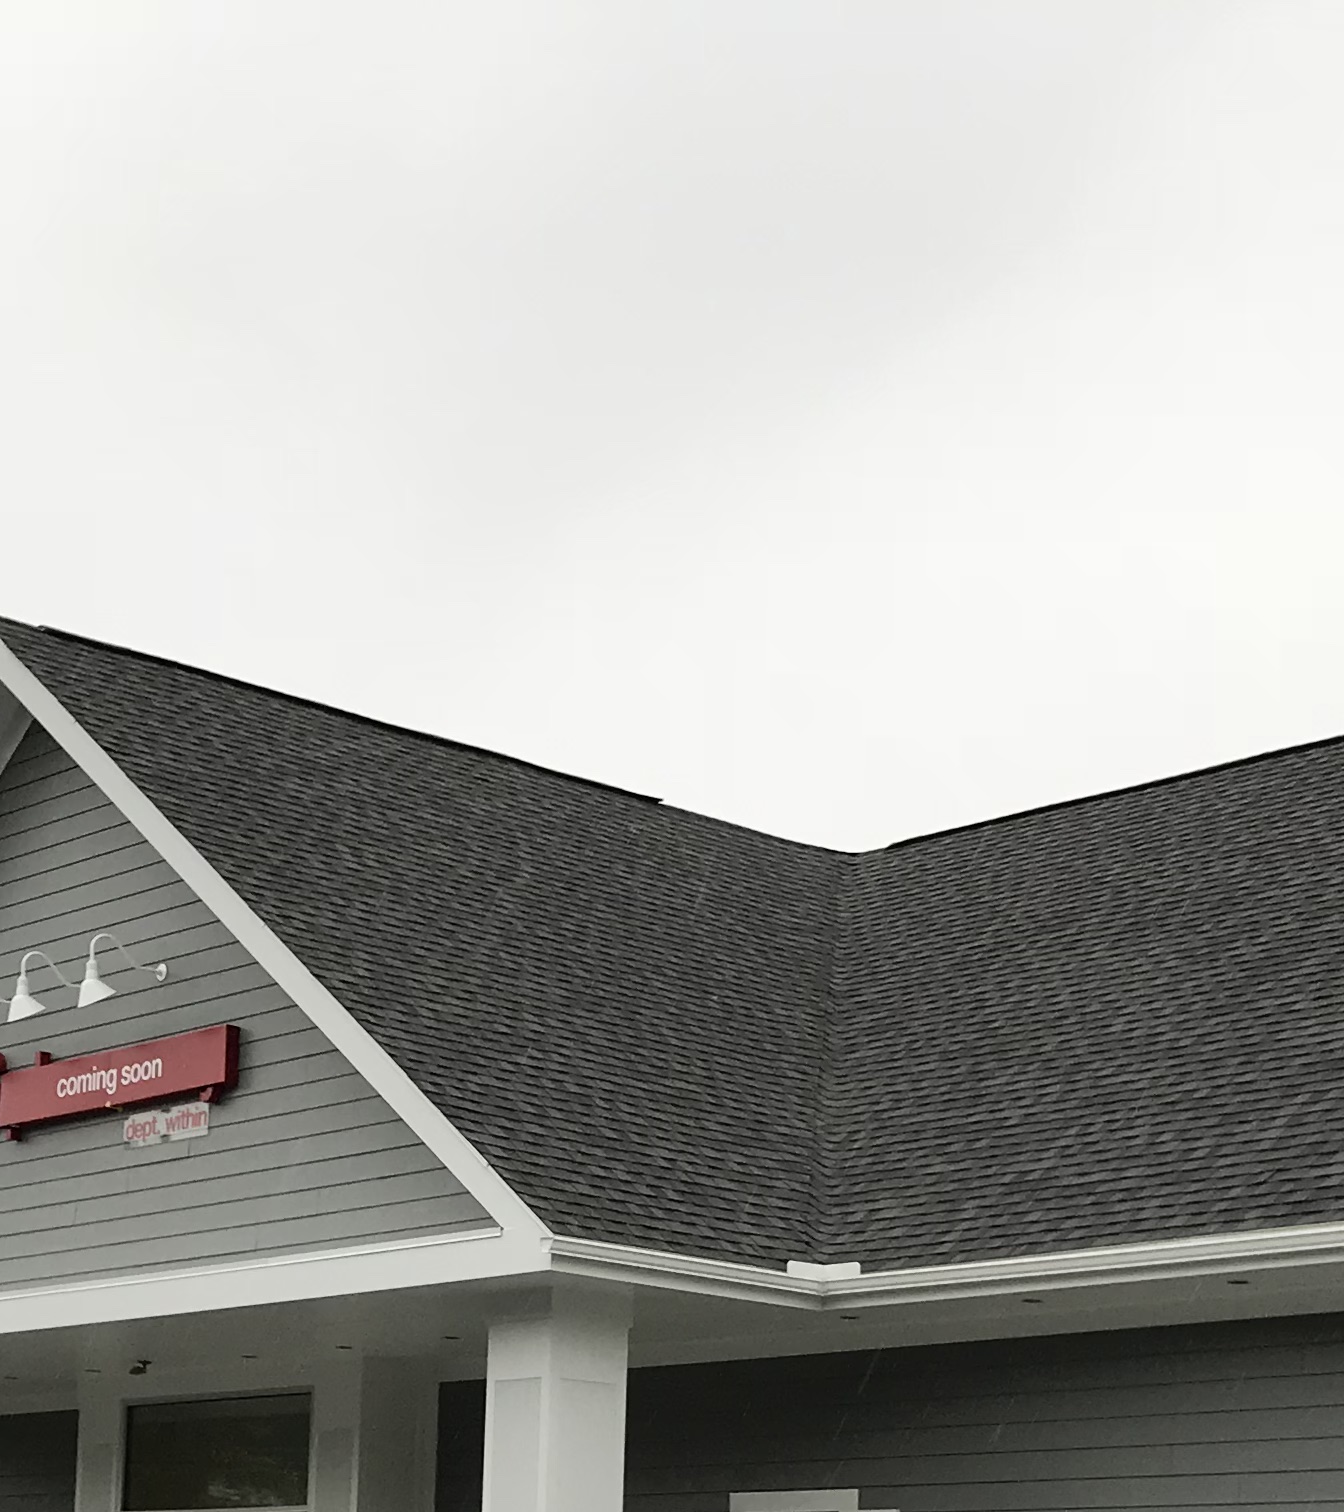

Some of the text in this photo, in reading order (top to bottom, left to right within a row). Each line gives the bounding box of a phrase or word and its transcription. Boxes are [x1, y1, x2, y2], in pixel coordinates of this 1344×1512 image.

[57, 1058, 162, 1098] coming soon
[126, 1106, 207, 1141] dept. within
